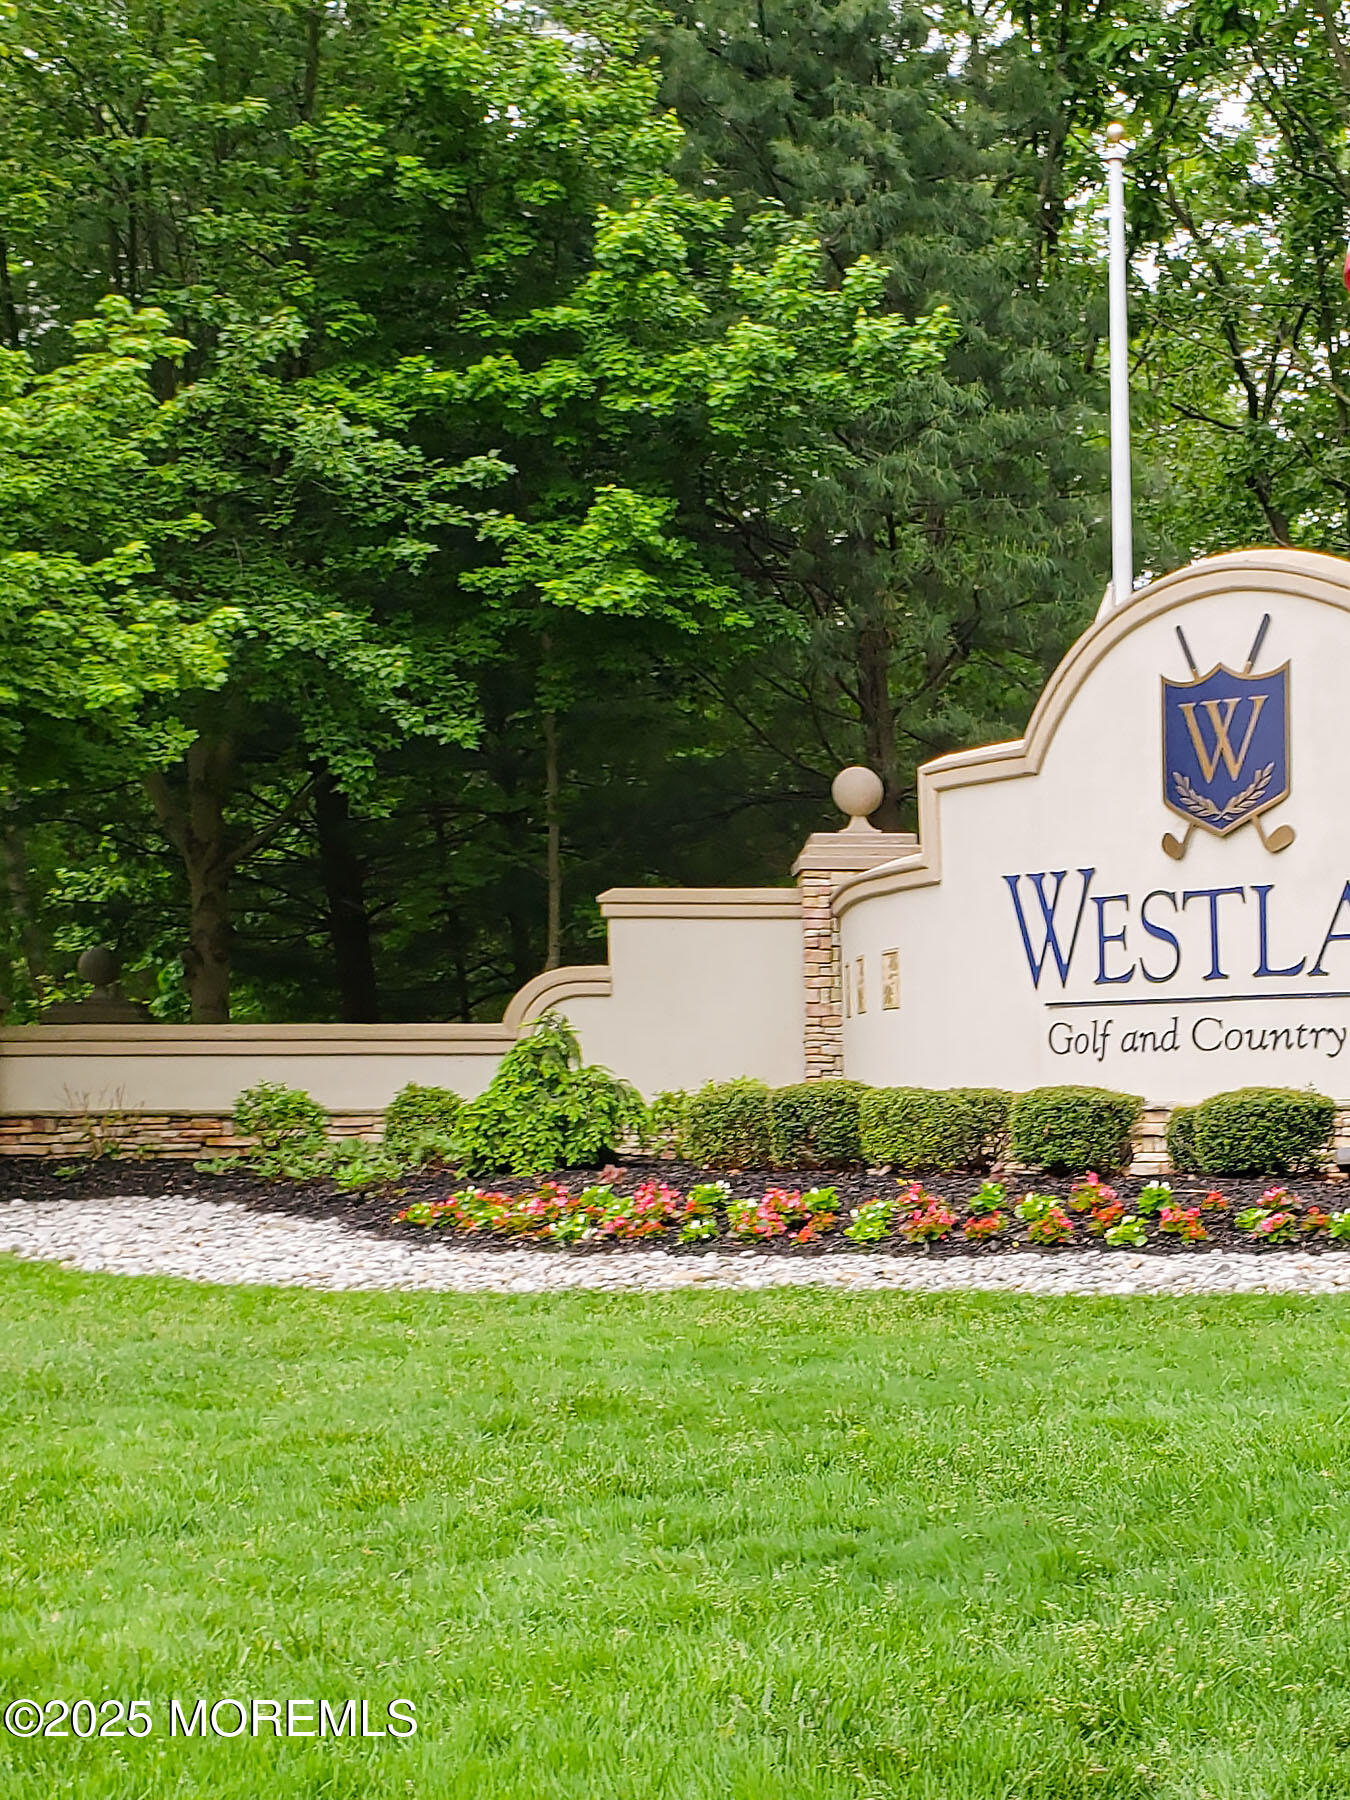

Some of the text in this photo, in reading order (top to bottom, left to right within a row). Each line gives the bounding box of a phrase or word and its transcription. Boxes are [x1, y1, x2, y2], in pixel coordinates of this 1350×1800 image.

[1178, 694, 1270, 785] W
[1047, 1019, 1113, 1062] Golf
[1120, 1016, 1179, 1054] and
[1191, 1016, 1347, 1058] Country
